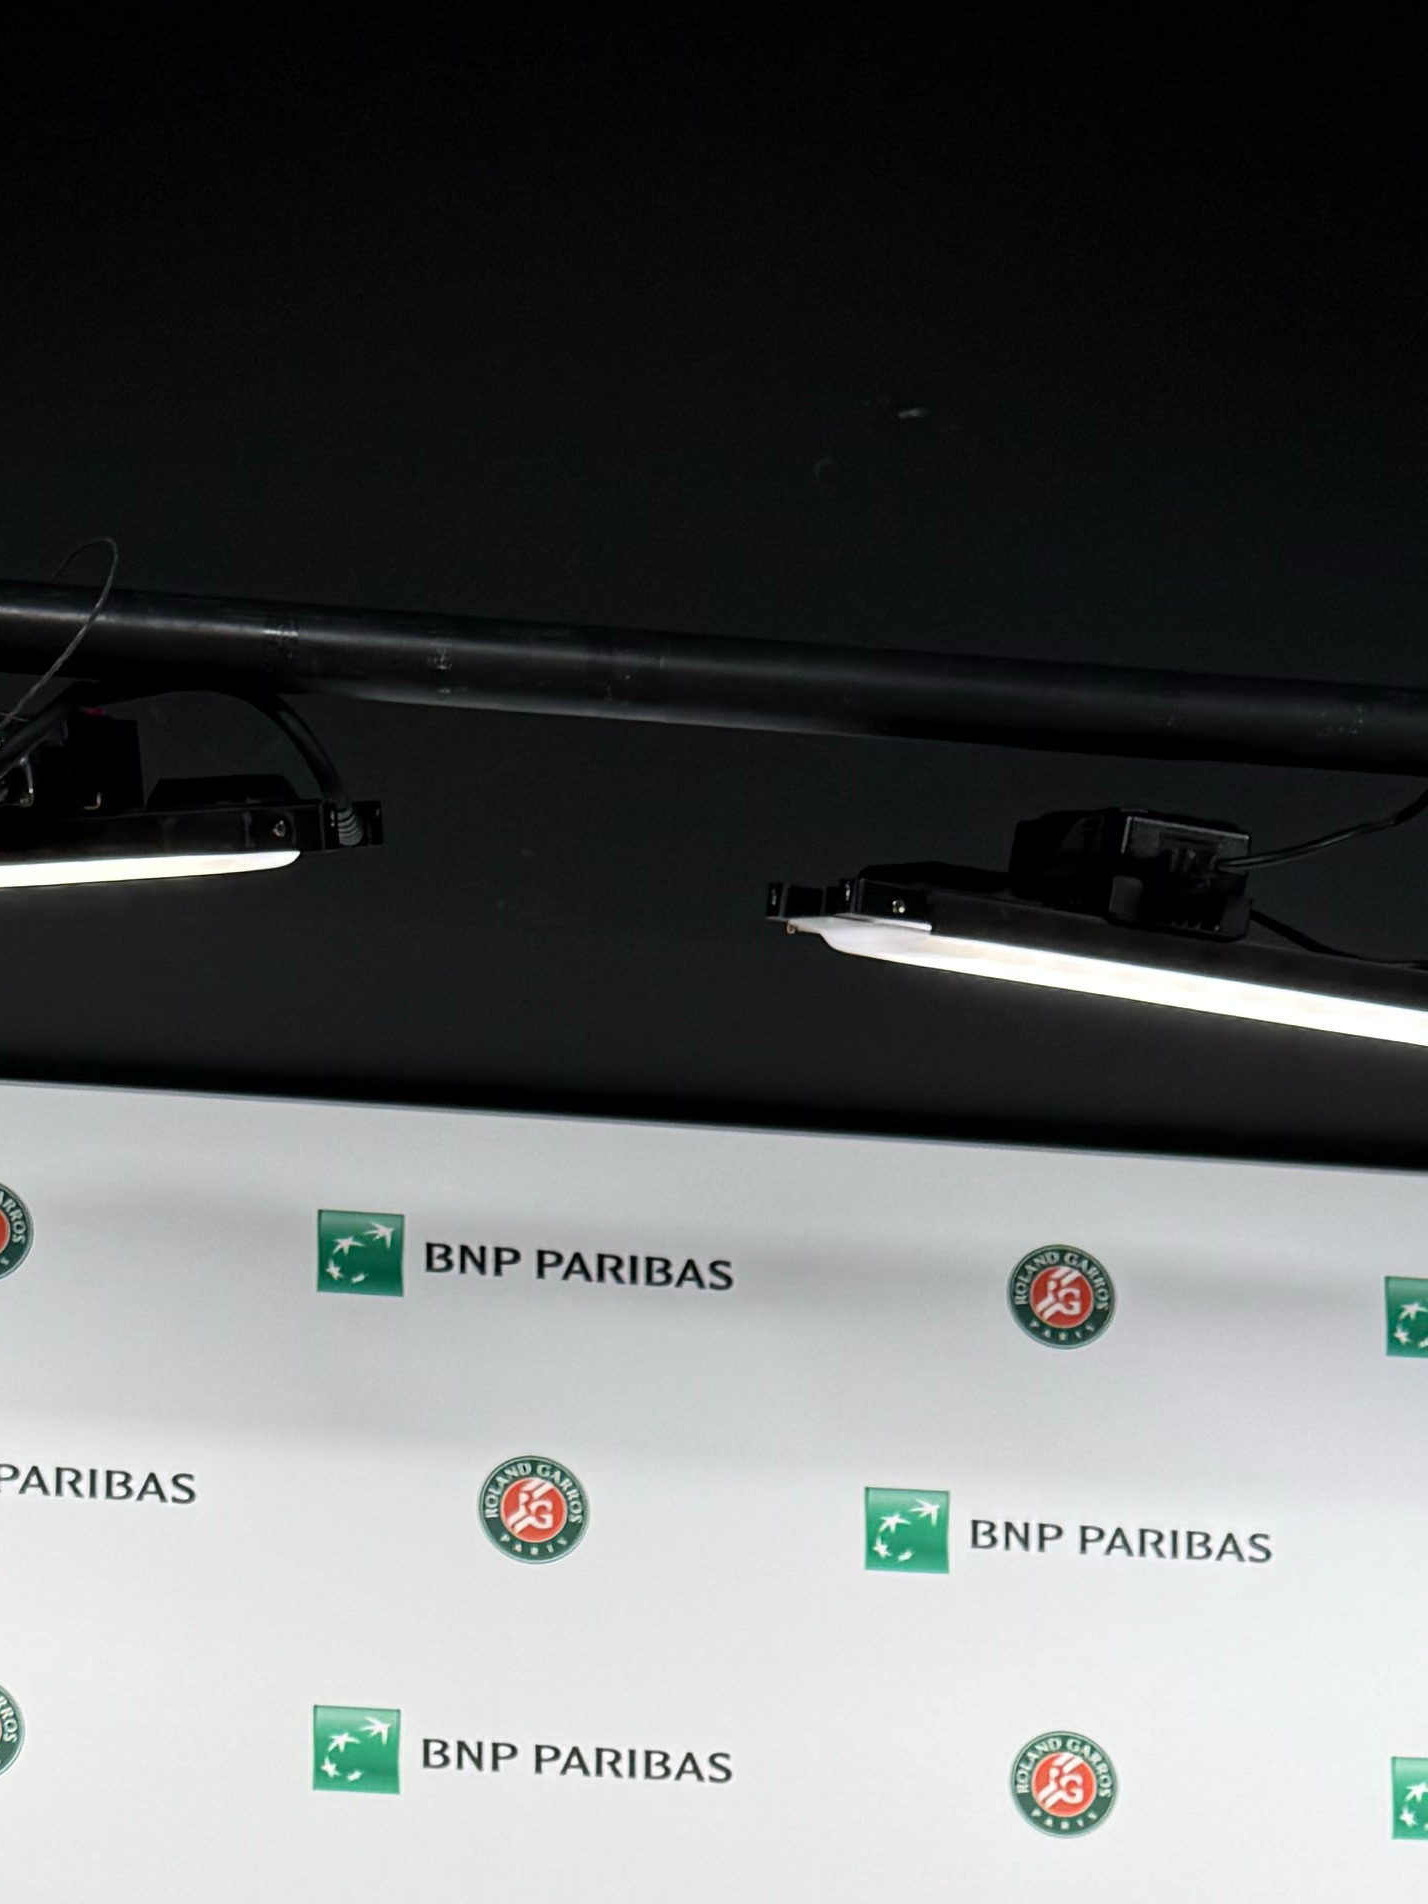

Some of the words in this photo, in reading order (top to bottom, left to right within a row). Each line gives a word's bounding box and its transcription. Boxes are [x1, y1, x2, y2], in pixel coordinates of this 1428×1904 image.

[425, 1241, 522, 1277] BNP
[536, 1248, 734, 1291] PARIBAS
[1013, 1250, 1059, 1305] ROLAND
[1064, 1252, 1110, 1310] GARROS
[484, 1461, 532, 1519] ROLAND
[536, 1462, 583, 1523] GARROS
[971, 1519, 1064, 1552] BNP
[1080, 1525, 1272, 1563] PARIBAS
[422, 1738, 518, 1772] BNP
[534, 1744, 732, 1783] PARIBAS
[1015, 1737, 1062, 1794] ROLAND
[1066, 1737, 1113, 1797] GARROS
